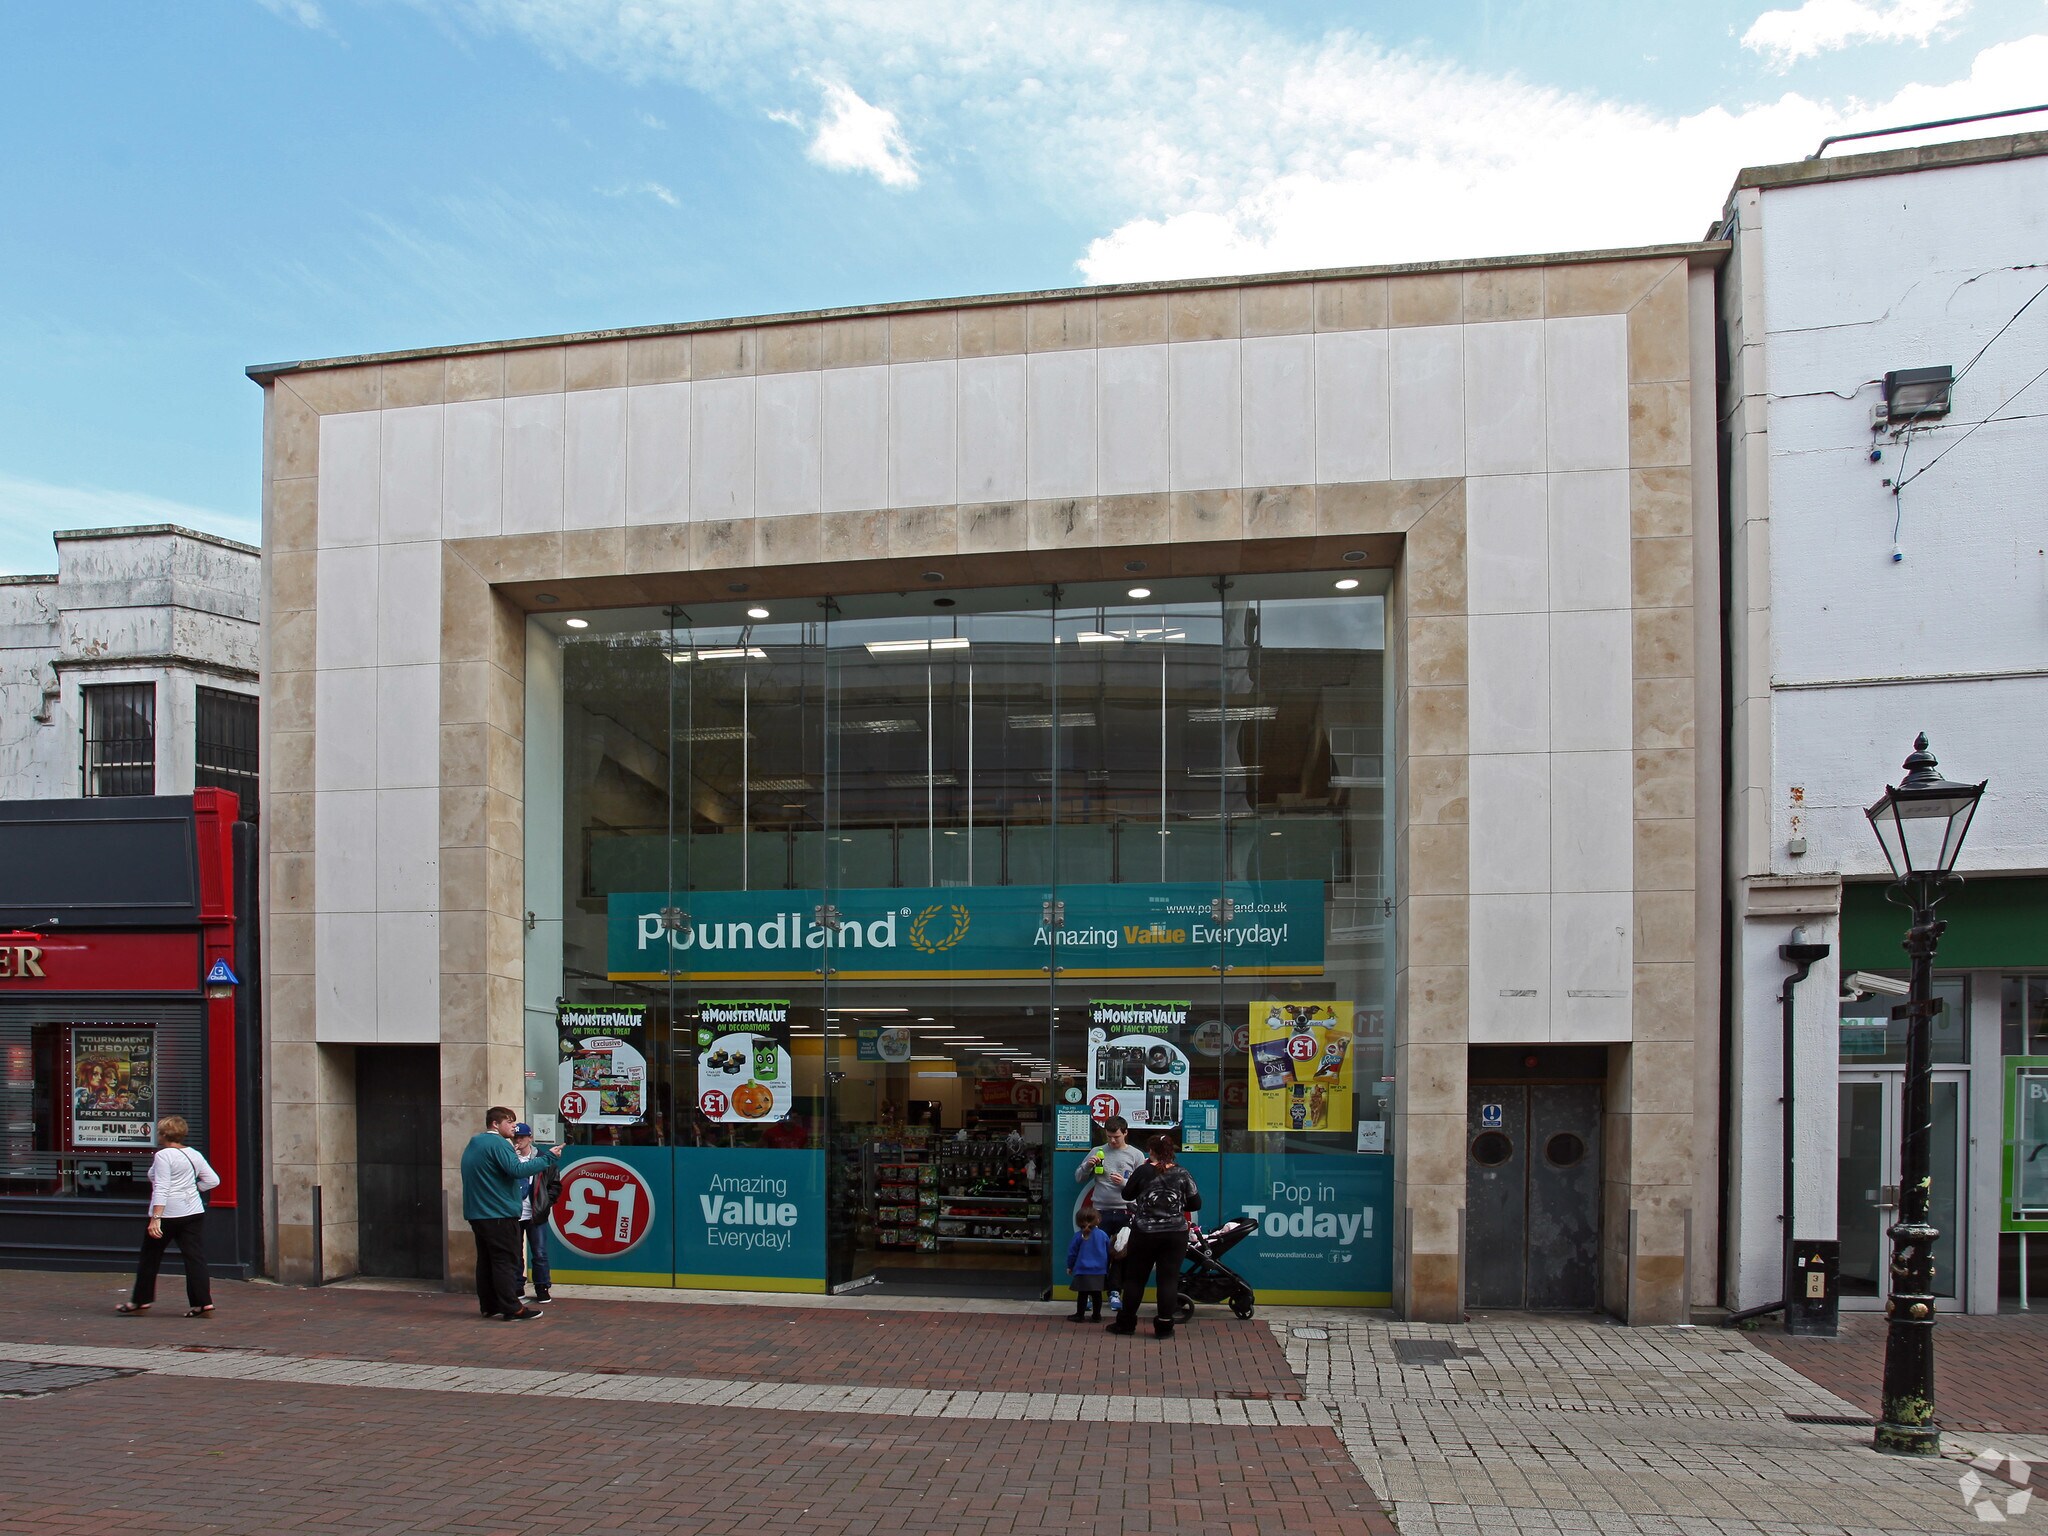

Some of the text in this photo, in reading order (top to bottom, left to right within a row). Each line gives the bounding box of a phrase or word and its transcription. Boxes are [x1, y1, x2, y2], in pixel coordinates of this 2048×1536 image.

[1166, 902, 1287, 914] www.poand.co.uk
[1033, 923, 1288, 948] Amazing Value Everyday!
[572, 1027, 631, 1035] ON TRICK OR TREAT
[717, 1023, 771, 1031] ON DECORATIONS
[1110, 1025, 1168, 1033] ON FANCY DRESS
[80, 1045, 150, 1054] TUESDAYS!
[593, 1040, 622, 1048] Exclusive
[1292, 1040, 1313, 1057] £1
[1264, 1063, 1286, 1074] ONE
[563, 1096, 583, 1114] £1
[704, 1095, 724, 1113] £1
[1092, 1098, 1115, 1117] £1
[102, 1124, 126, 1134] FUN
[709, 1173, 787, 1198] Amazing
[1272, 1181, 1335, 1205] Pop in
[563, 1177, 637, 1243] £1
[699, 1194, 797, 1226] Value
[619, 1216, 630, 1239] EACH
[1241, 1205, 1374, 1245] Today!
[708, 1227, 791, 1251] Everyday!
[1259, 1251, 1324, 1259] www.poundland.co.uk
